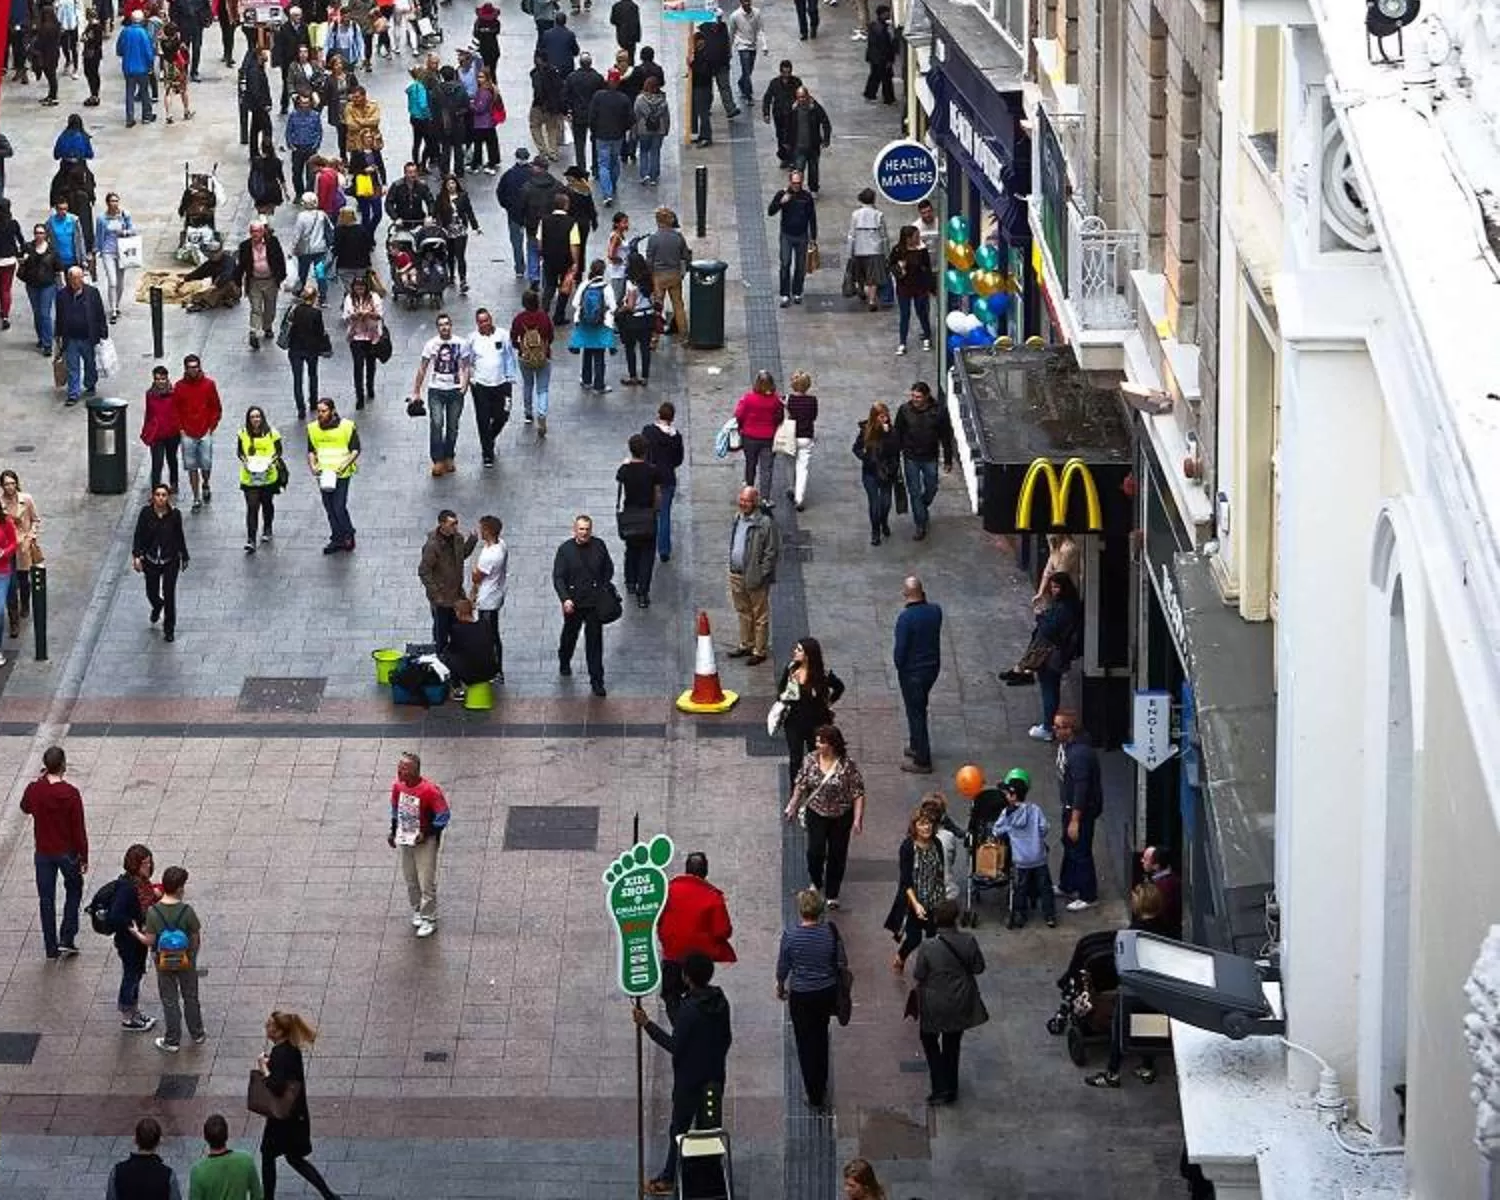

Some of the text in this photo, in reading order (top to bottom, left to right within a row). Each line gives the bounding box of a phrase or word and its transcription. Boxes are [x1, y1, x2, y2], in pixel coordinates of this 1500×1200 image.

[885, 156, 927, 171] HEALTH
[881, 171, 933, 187] MATTERS
[1147, 698, 1158, 763] ENGLISH
